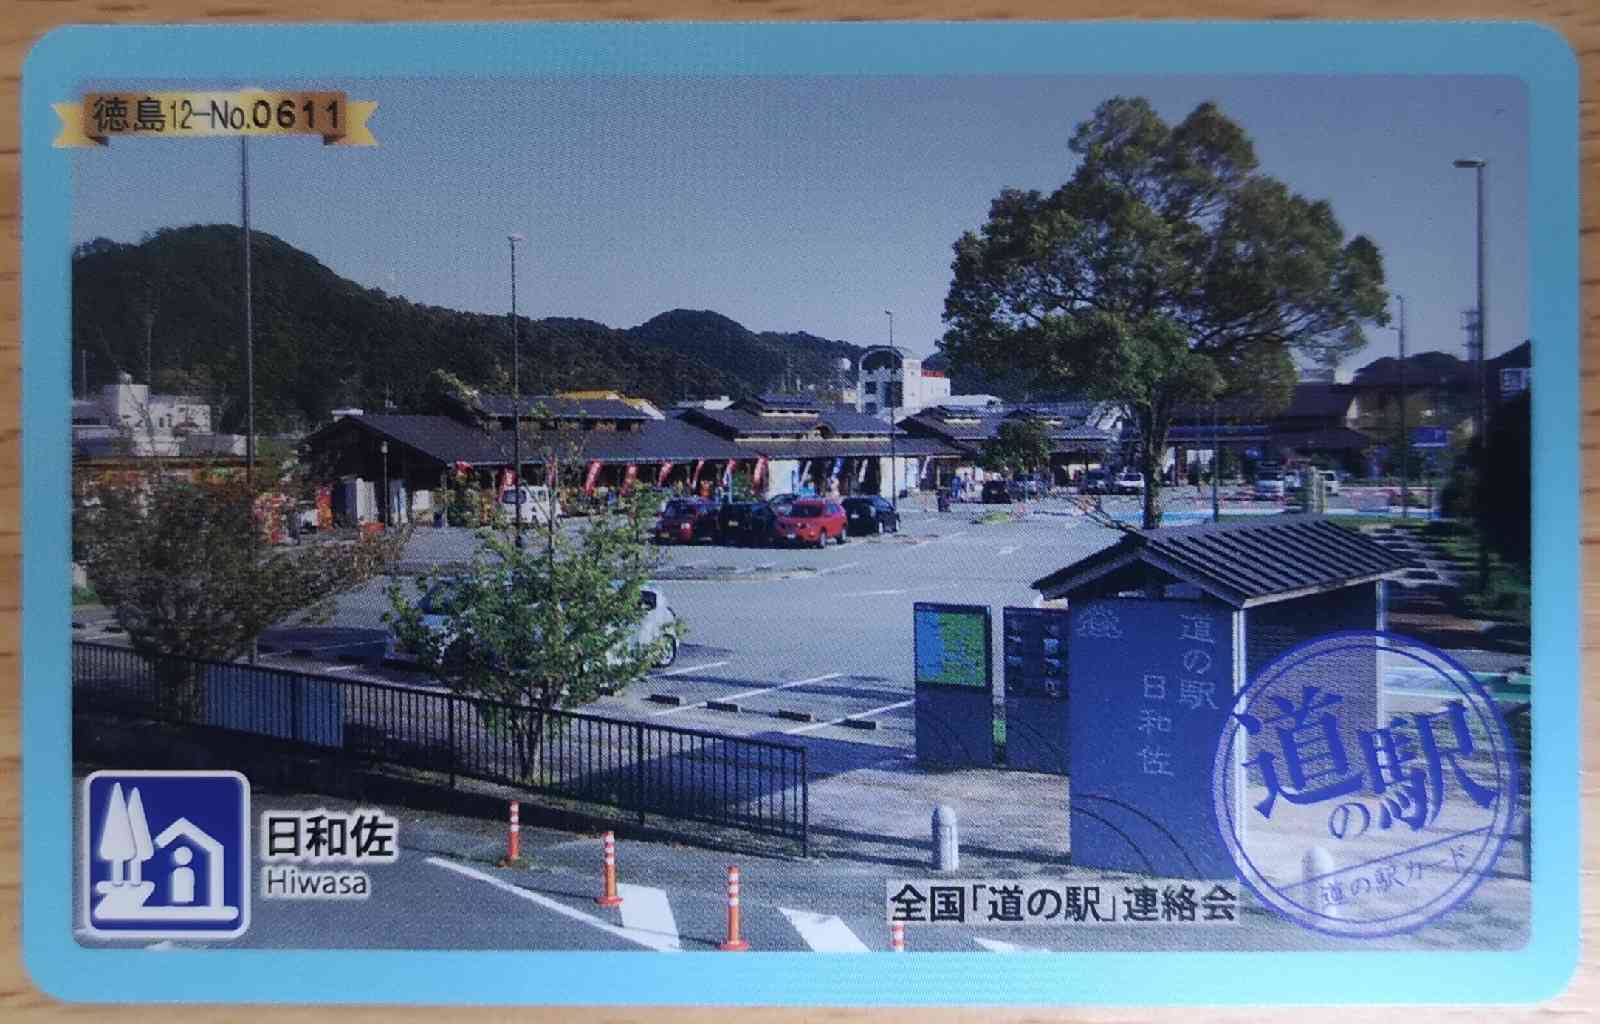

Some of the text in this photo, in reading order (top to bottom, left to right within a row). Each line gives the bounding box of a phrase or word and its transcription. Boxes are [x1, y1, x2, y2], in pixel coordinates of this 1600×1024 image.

[1179, 614, 1219, 710] 道の駅
[1137, 674, 1174, 777] 日和佐
[1234, 687, 1498, 838] 道の駅
[268, 816, 394, 857] 日和佐
[267, 869, 367, 894] Hiwasa
[890, 884, 1235, 923] 全国「道の駅」連絡会
[1322, 845, 1464, 905] 道の駅カード
